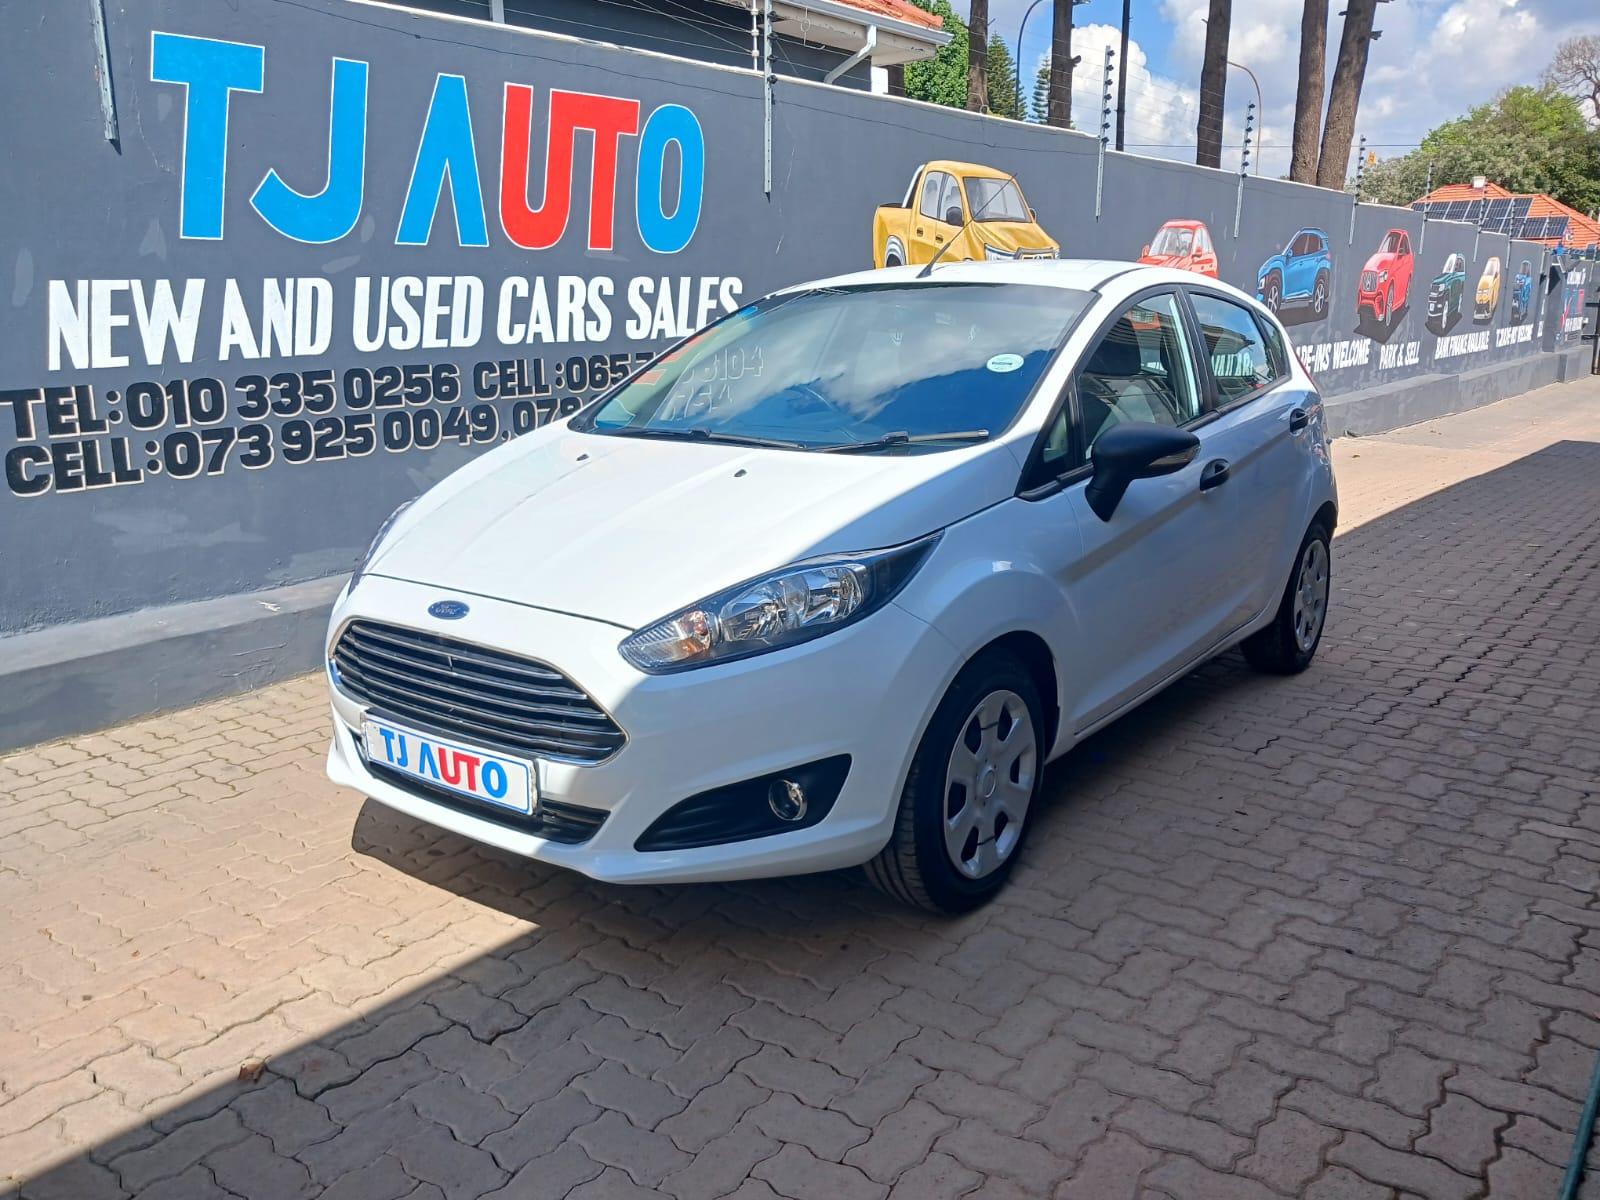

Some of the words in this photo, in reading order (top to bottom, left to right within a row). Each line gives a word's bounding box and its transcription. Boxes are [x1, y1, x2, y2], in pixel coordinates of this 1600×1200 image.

[150, 30, 369, 244] TJ
[394, 72, 705, 254] AUTO
[48, 278, 206, 371] NEW
[218, 277, 334, 361] AND
[352, 275, 485, 352] USED
[496, 275, 615, 345] CARS
[625, 276, 743, 340] SALES
[1332, 338, 1372, 370] WELCOME
[1378, 343, 1399, 370] PARK
[1396, 343, 1405, 367] &
[1404, 340, 1421, 366] SELL
[235, 369, 337, 421] 335
[343, 363, 462, 410] 0256
[280, 413, 376, 464] 925
[379, 727, 409, 768] TJ
[418, 741, 508, 799] AUTO
